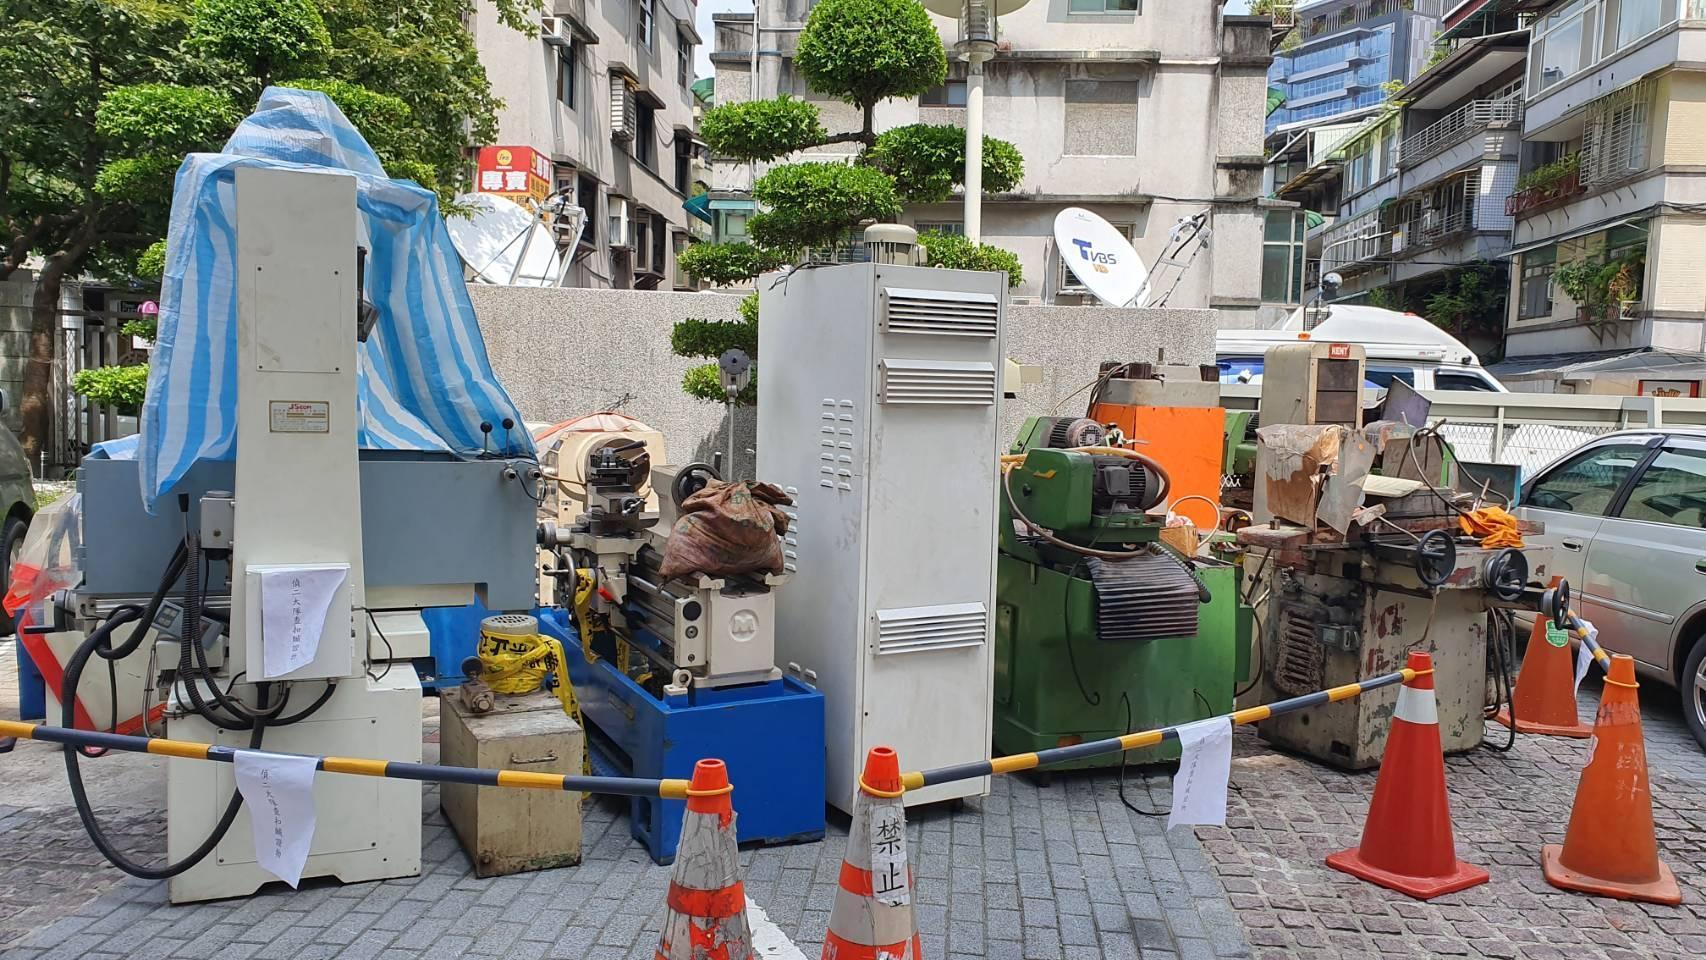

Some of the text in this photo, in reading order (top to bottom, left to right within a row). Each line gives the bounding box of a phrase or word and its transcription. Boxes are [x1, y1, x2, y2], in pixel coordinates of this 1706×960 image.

[481, 171, 527, 191] 專賣
[1072, 238, 1117, 265] TVBS
[872, 818, 905, 908] 禁止
